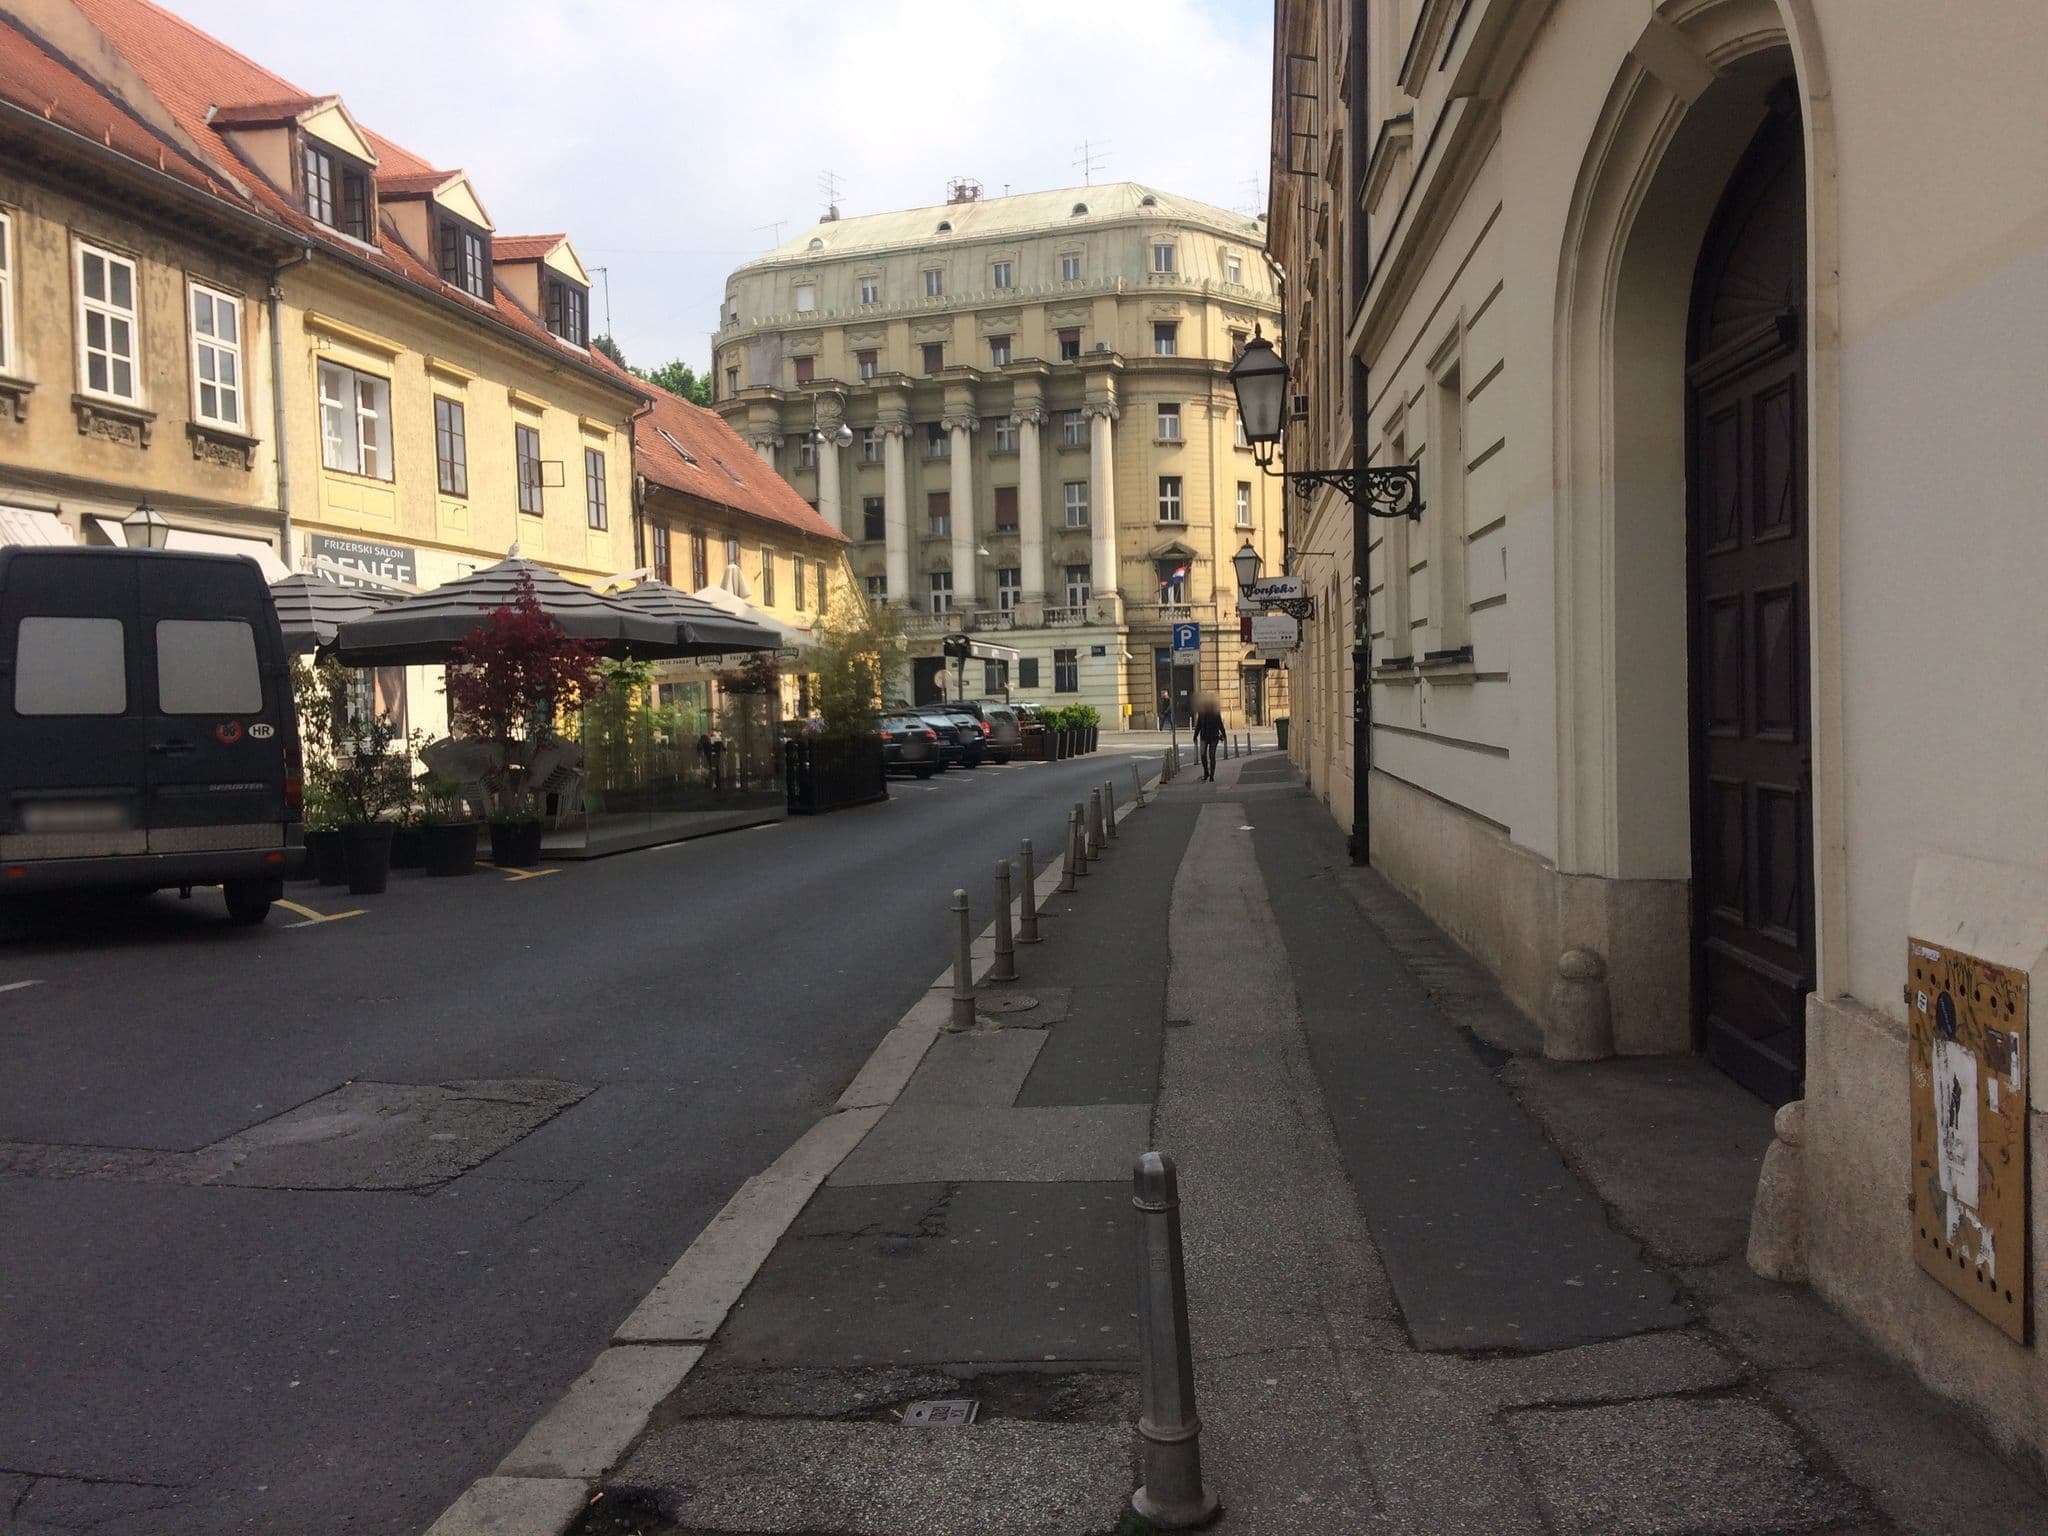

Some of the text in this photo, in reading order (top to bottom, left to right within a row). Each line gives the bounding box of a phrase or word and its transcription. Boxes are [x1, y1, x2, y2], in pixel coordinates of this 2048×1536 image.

[324, 539, 404, 559] FRIZERSKI SALON
[1181, 629, 1192, 647] P
[252, 726, 270, 736] HR
